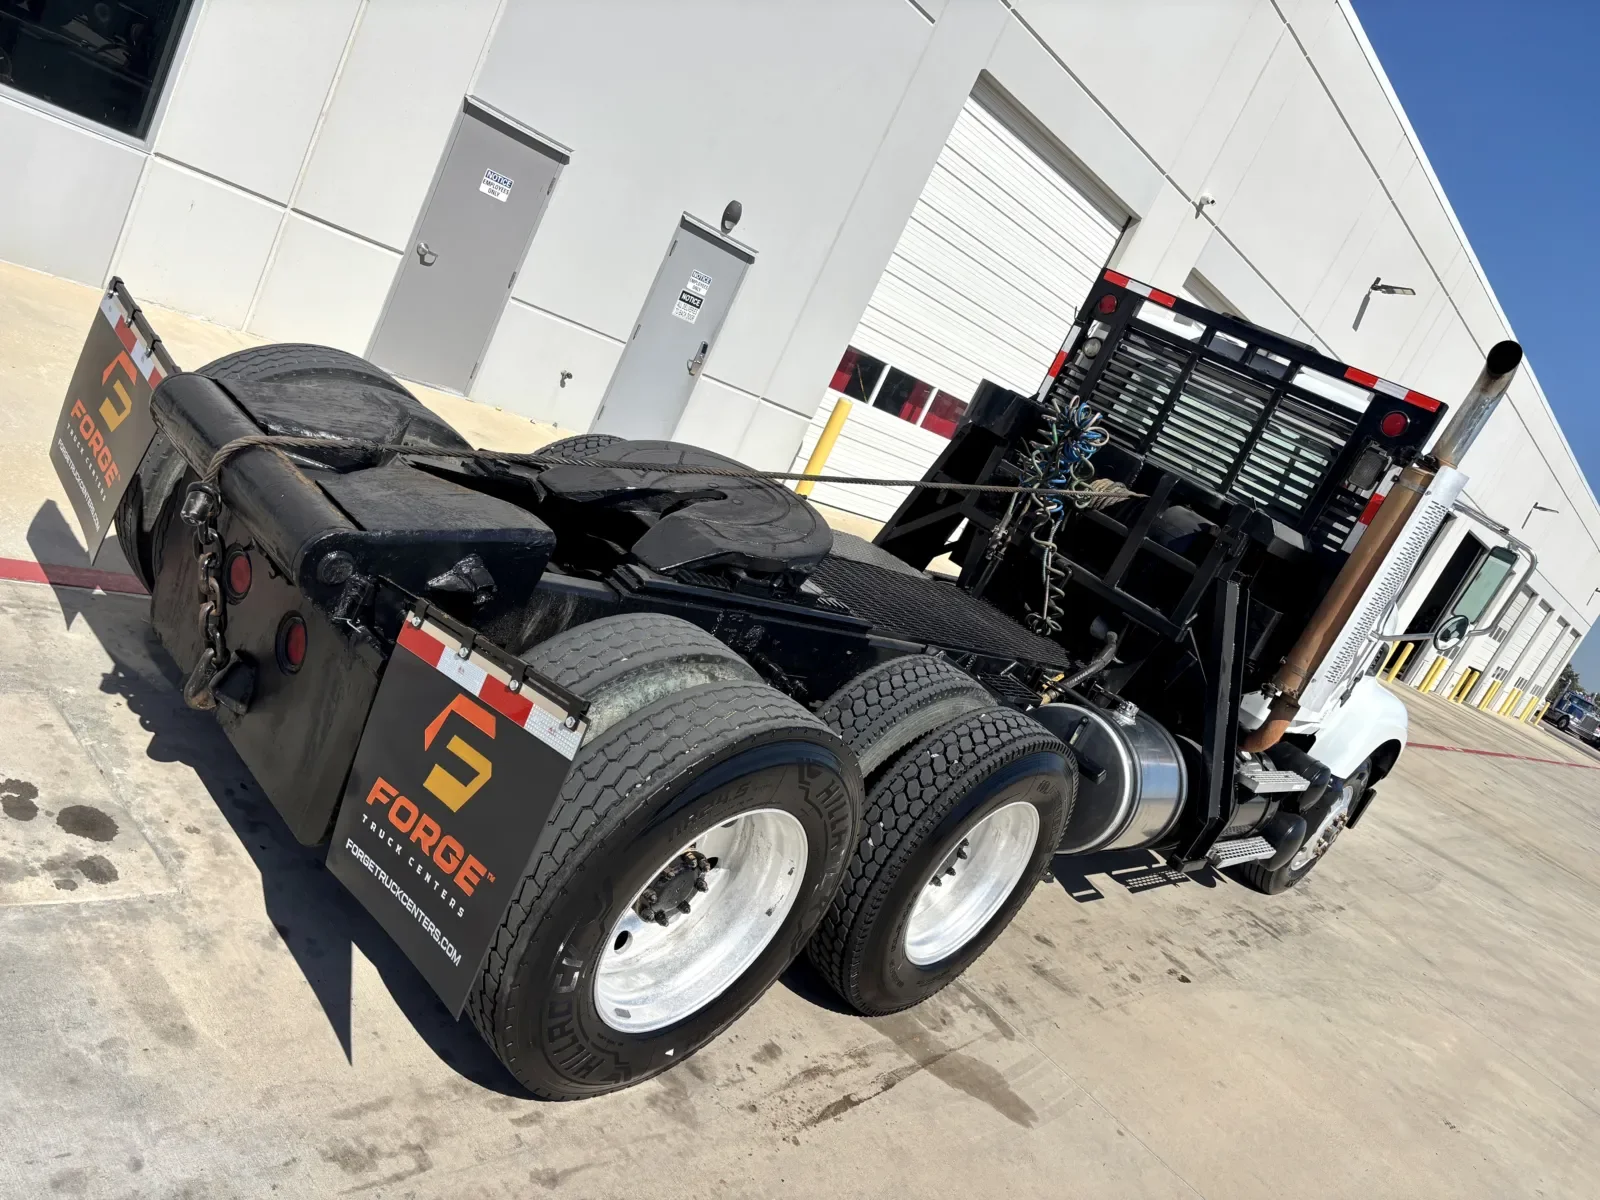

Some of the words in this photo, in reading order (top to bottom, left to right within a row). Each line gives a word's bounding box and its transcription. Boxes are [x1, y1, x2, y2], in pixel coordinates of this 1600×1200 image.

[482, 178, 510, 195] EMPLOYEES
[485, 169, 513, 189] NOTICE
[487, 187, 501, 197] ONLY
[691, 270, 712, 285] NOTICE
[680, 292, 702, 307] NOTICE
[66, 423, 85, 455] TRUCK
[70, 398, 119, 488] FORGE
[365, 776, 488, 897] FORGE
[362, 813, 403, 856] TRUCK
[408, 856, 465, 918] CENTERS
[345, 837, 462, 967] FORGETRUCKCENTERS.COM
